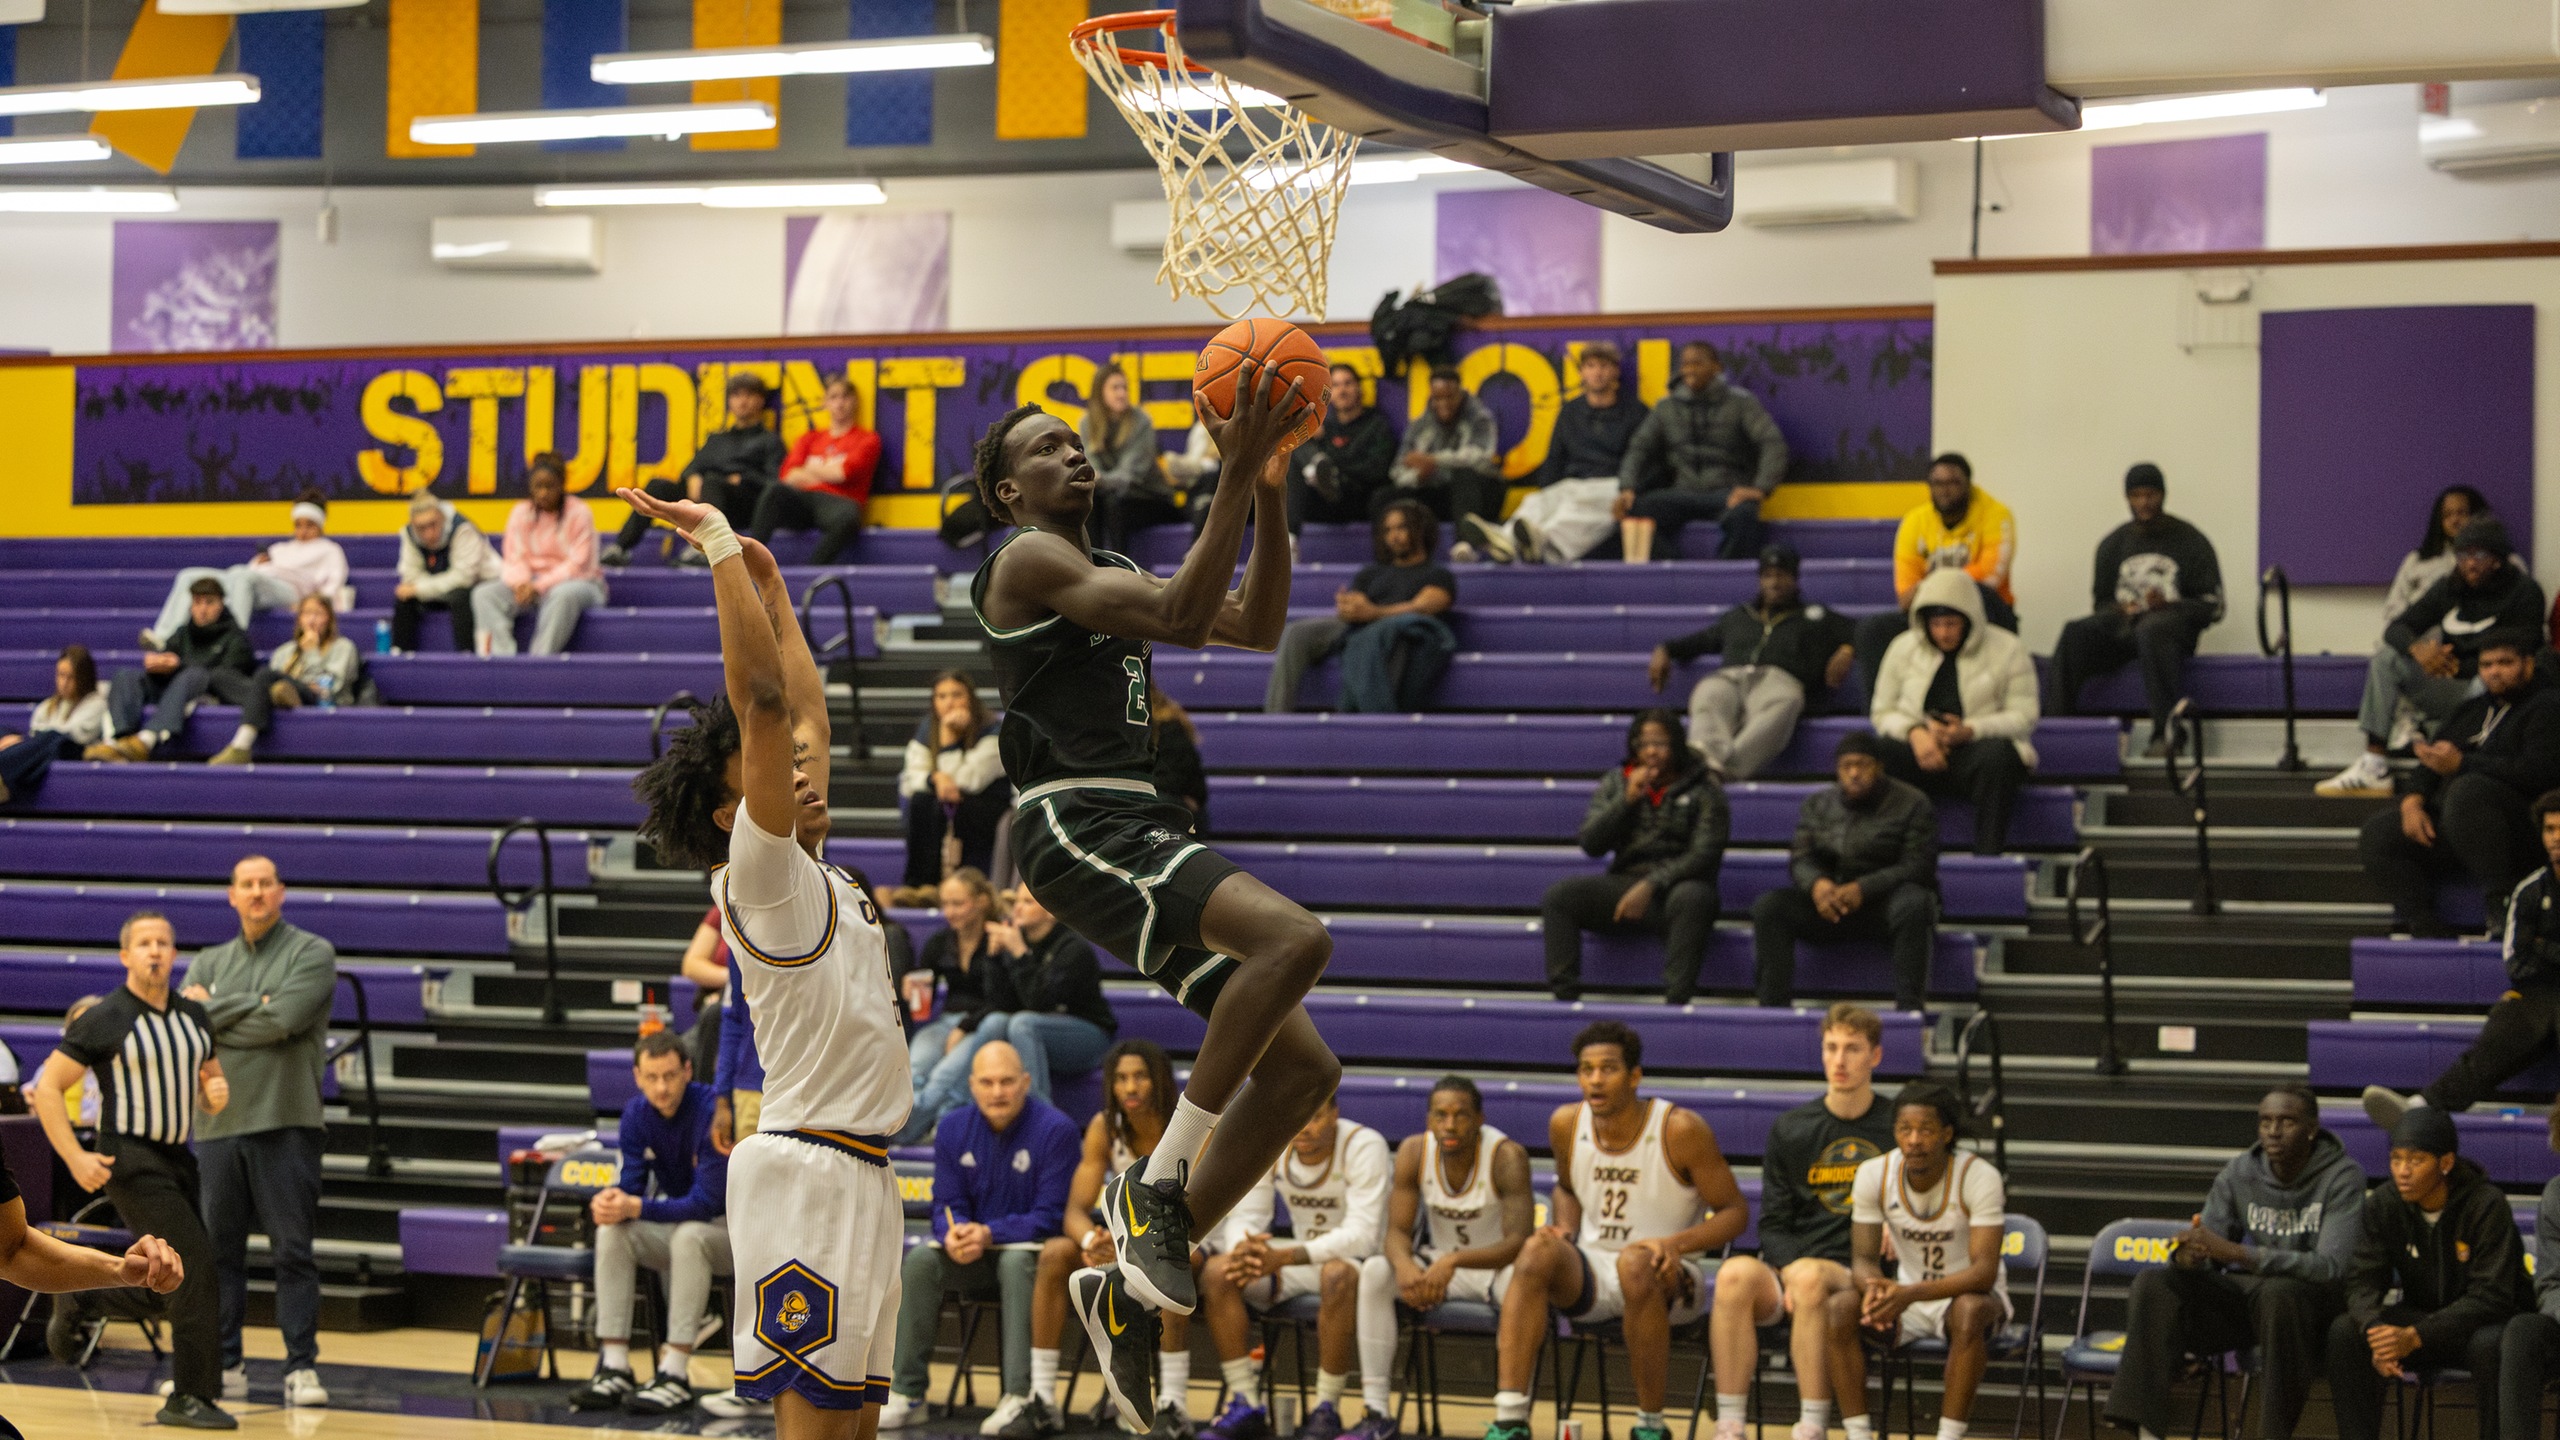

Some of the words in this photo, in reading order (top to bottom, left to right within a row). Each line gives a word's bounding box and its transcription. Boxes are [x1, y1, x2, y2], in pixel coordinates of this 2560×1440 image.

[1122, 655, 1150, 727] 2
[1593, 1166, 1641, 1185] DODGE
[1601, 1187, 1628, 1220] 32
[1455, 1224, 1470, 1246] 5
[1922, 1246, 1945, 1270] 12
